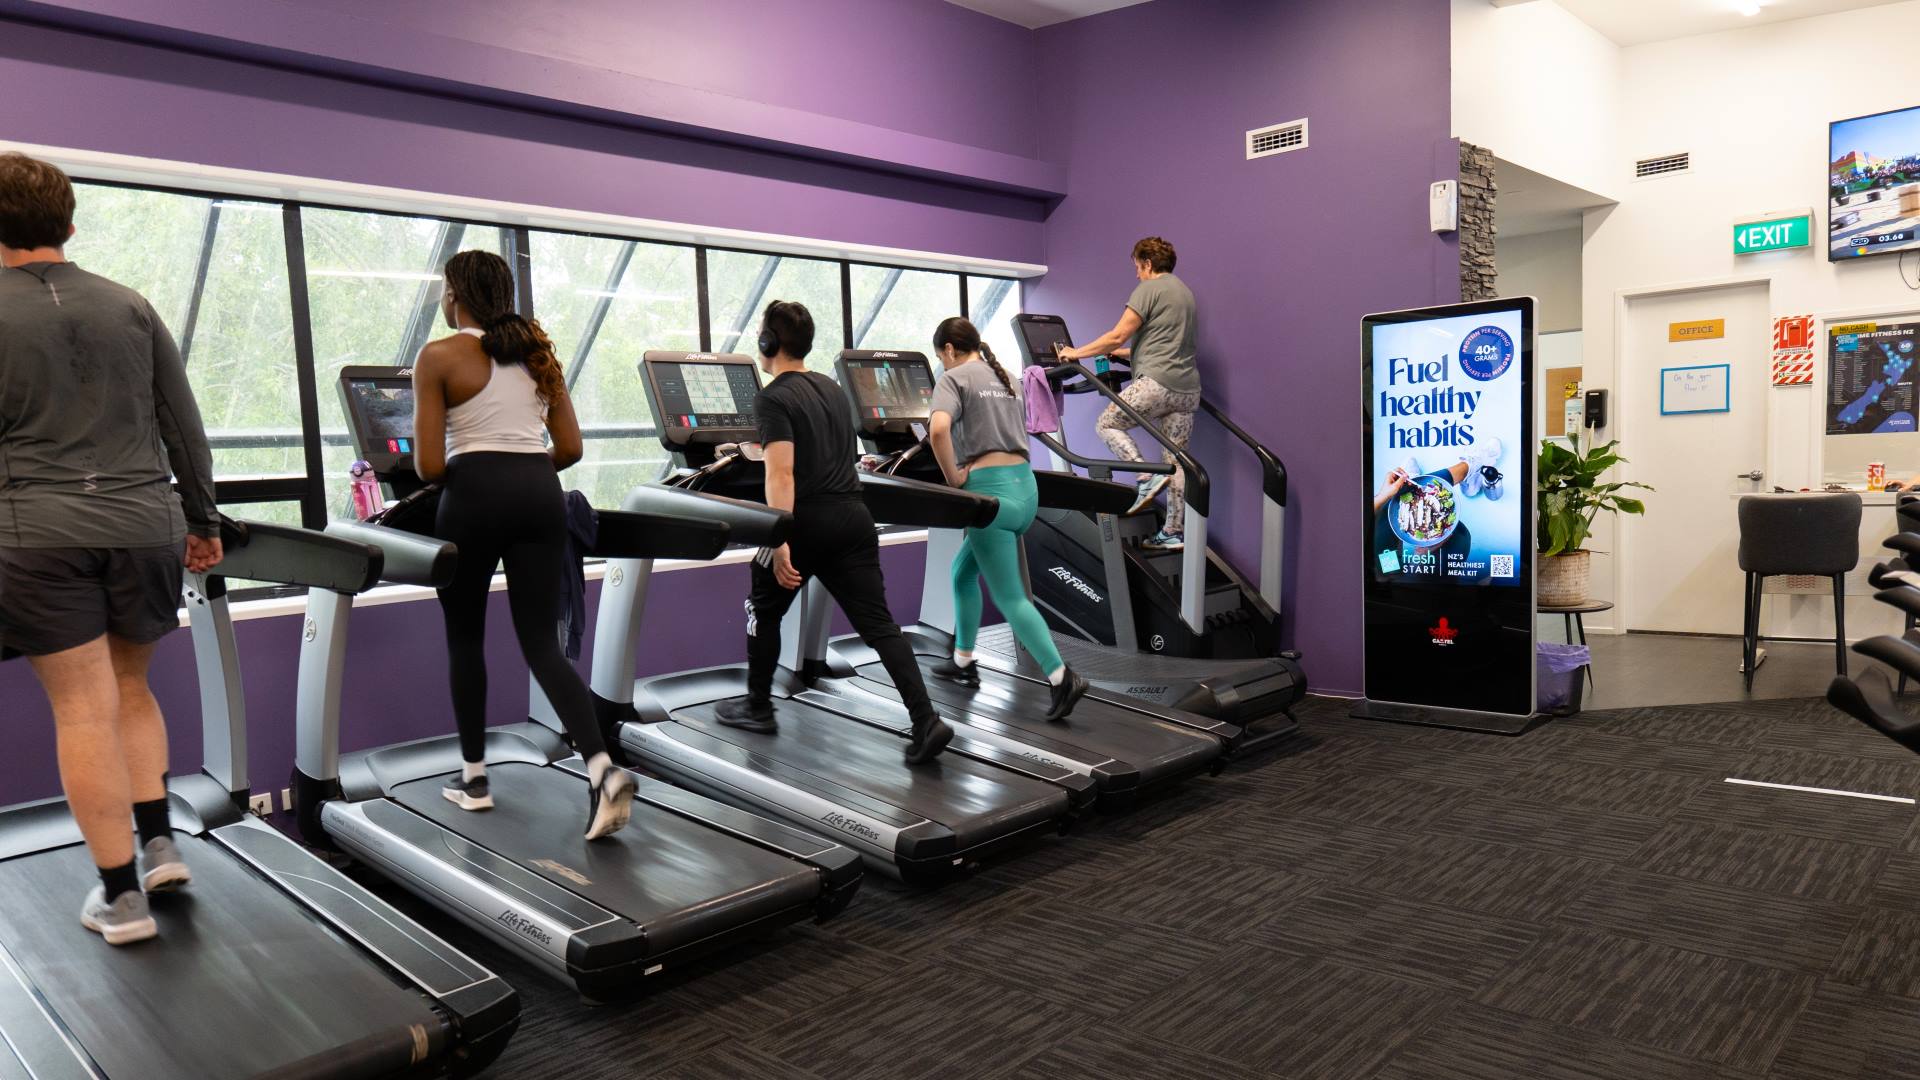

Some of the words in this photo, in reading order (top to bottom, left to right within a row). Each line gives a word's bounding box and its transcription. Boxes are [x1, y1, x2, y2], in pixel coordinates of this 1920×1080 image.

[1749, 223, 1793, 248] EXIT
[1678, 325, 1715, 336] OFFICE
[1871, 329, 1902, 338] FITNESS
[1462, 331, 1481, 353] PROTEIN
[1475, 344, 1497, 355] 40+
[1474, 354, 1498, 362] GRAMS
[1389, 354, 1448, 386] Fuel
[1380, 385, 1482, 419] healthy
[1389, 419, 1475, 448] habits
[1402, 549, 1436, 565] fresh
[1402, 565, 1436, 574] START
[1447, 561, 1486, 569] HEALTHIEST
[1126, 686, 1169, 694] ASSAULT
